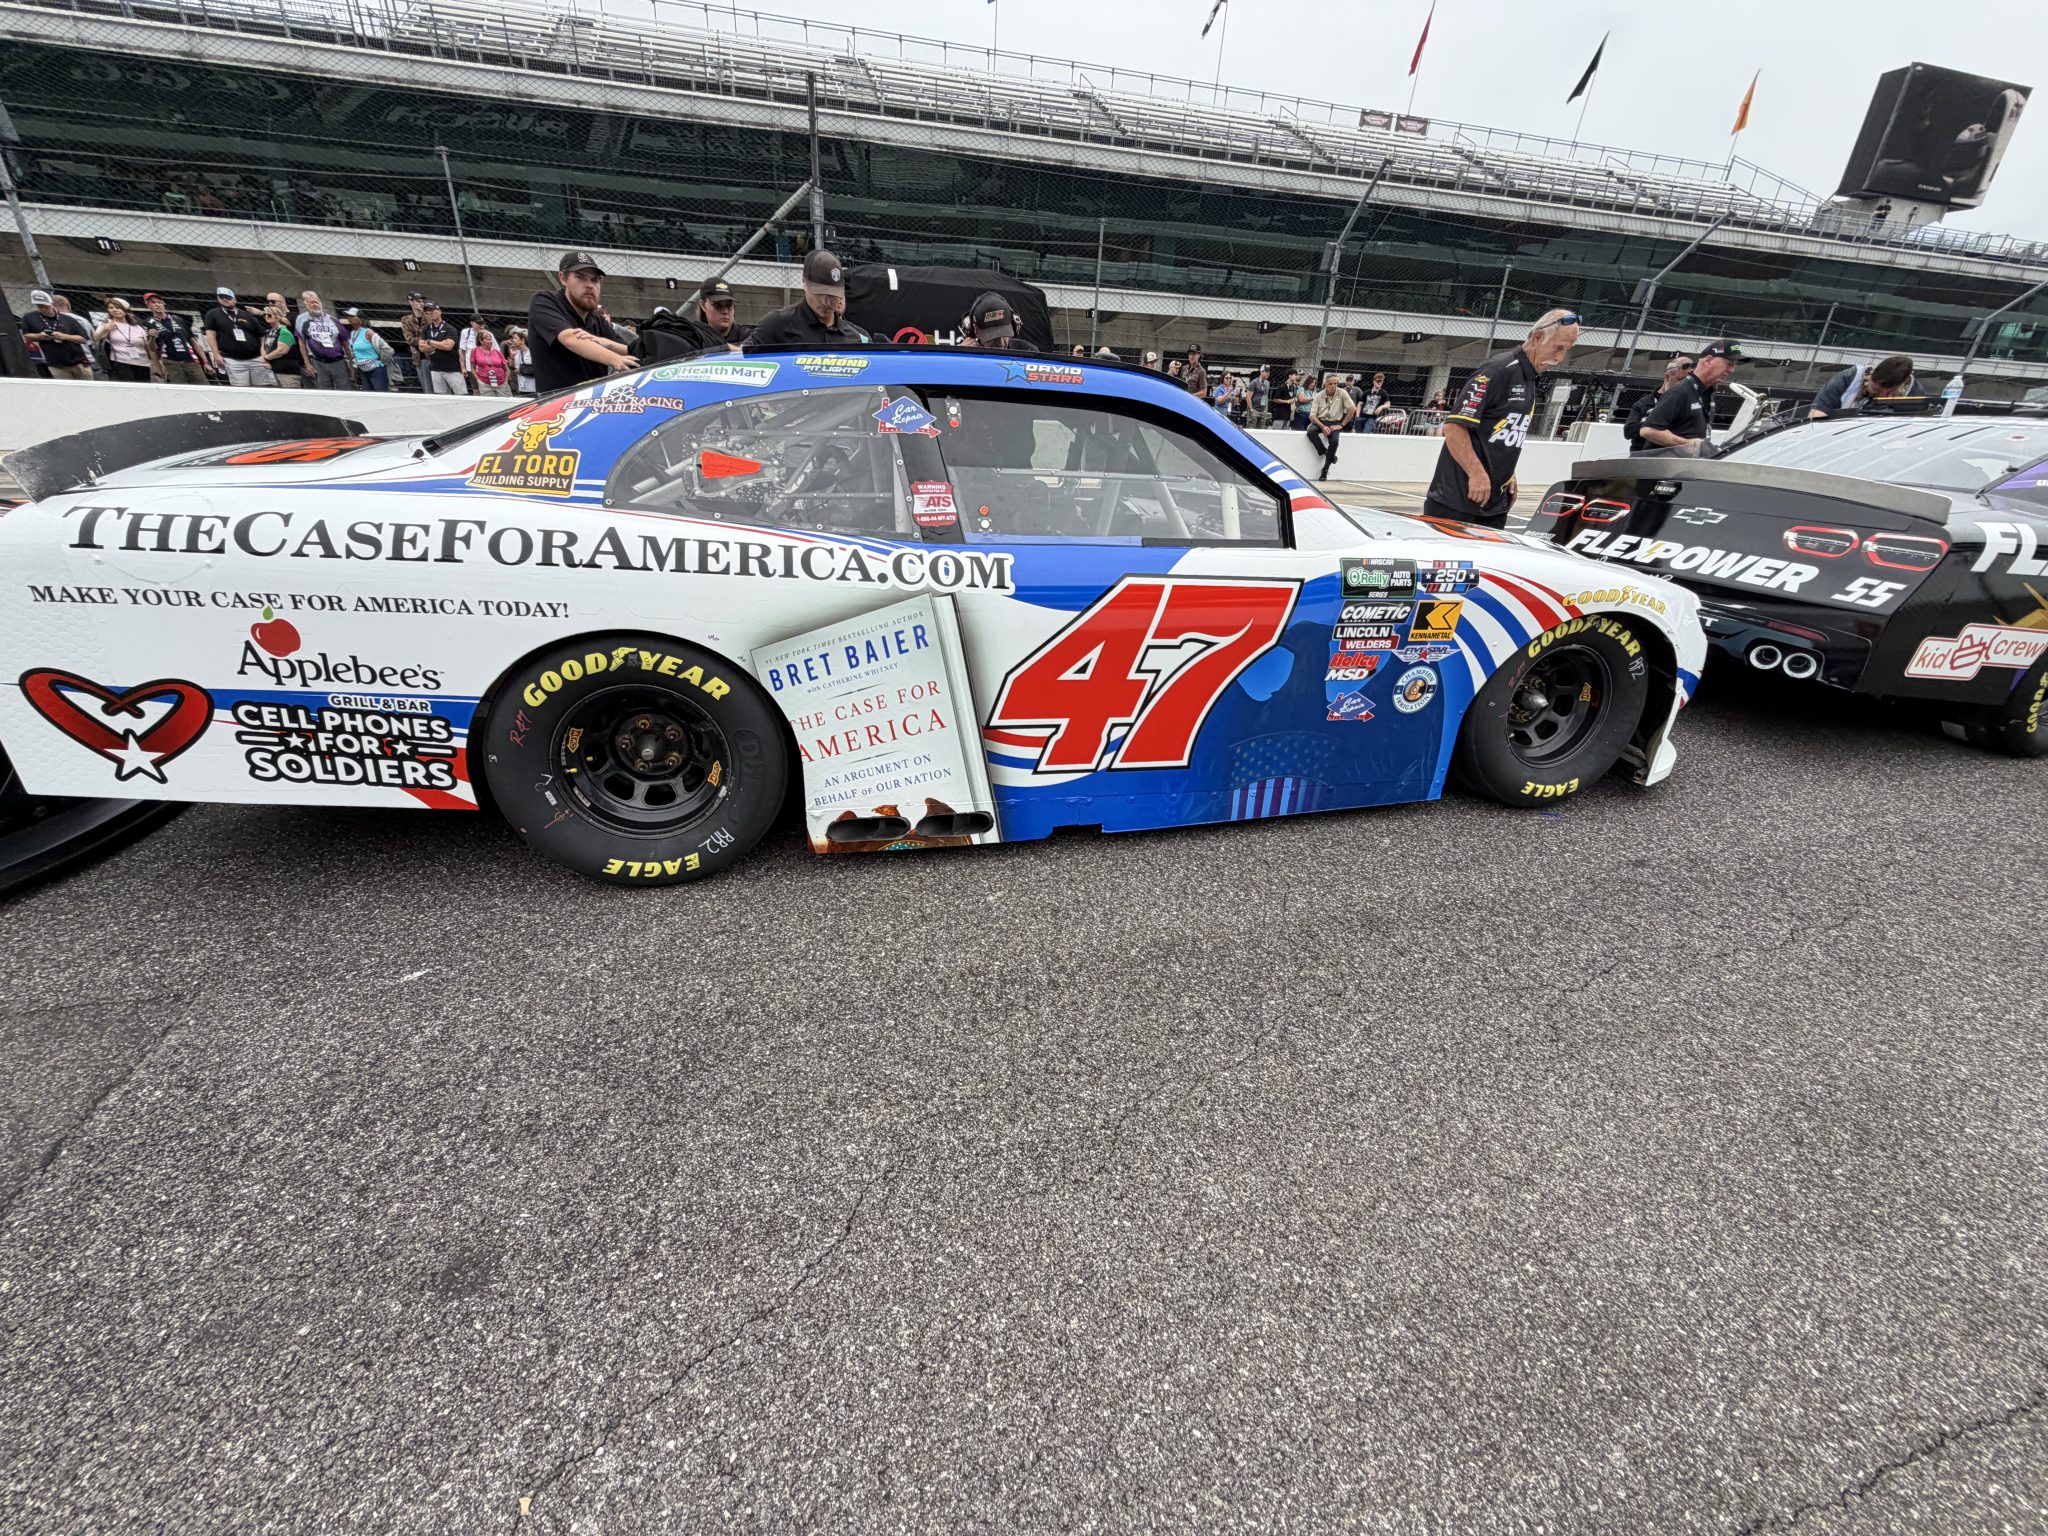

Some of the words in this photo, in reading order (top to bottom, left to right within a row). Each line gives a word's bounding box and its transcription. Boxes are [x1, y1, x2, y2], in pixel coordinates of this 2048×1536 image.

[668, 279, 676, 290] 9
[795, 356, 869, 367] DIAMOND
[802, 365, 822, 373] PIT
[824, 365, 860, 374] LIGHTS
[1025, 364, 1082, 375] DAVID
[682, 366, 728, 375] Health
[731, 367, 767, 379] Mart
[1027, 372, 1084, 385] STARR
[562, 398, 607, 410] FLURRY
[631, 396, 684, 411] RACING
[592, 404, 645, 414] STABLES
[894, 404, 917, 416] Car
[892, 412, 924, 425] Repair
[477, 455, 502, 474] EL
[513, 454, 576, 476] TORO
[473, 475, 524, 486] BUILDING
[526, 475, 570, 489] SUPPLY
[926, 495, 952, 508] ATS
[1370, 558, 1395, 566] NASCAR
[1565, 528, 1820, 594] FLEXPOWER
[1347, 568, 1390, 587] O'Reilly
[1390, 578, 1413, 587] PARTS
[1392, 570, 1411, 579] AUTO
[1434, 569, 1467, 583] 250
[1830, 576, 1909, 608] 55
[27, 585, 118, 605] MAKE
[121, 588, 206, 607] YOUR
[210, 591, 284, 609] CASE
[288, 593, 347, 612] FOR
[353, 596, 475, 615] AMERICA
[478, 599, 570, 618] TODAY!
[1341, 605, 1412, 620] COMETIC
[792, 645, 811, 658] YORK
[813, 638, 836, 653] TIMES
[838, 621, 890, 643] BESTSELLING
[892, 610, 925, 626] AUTHOR
[1336, 626, 1391, 638] LINCOLN
[1410, 632, 1451, 640] KENNAMETAL
[1345, 639, 1392, 650] WELDERS
[1993, 639, 2047, 658] crew
[237, 640, 441, 690] Applebee's
[768, 652, 832, 692] BRET
[844, 624, 930, 670] BAIER
[1330, 652, 1380, 671] Holley
[1914, 646, 1951, 669] kid
[806, 685, 821, 694] with
[822, 672, 863, 690] CATHERINE
[864, 662, 899, 677] WHITNEY
[987, 573, 1304, 774] 47
[1325, 669, 1370, 681] MSD
[1401, 668, 1436, 684] CHAMPION
[331, 694, 379, 709] GRILL
[382, 698, 393, 710] &
[396, 700, 430, 712] BAR
[834, 694, 888, 721] CASE
[897, 680, 942, 704] FOR
[1395, 694, 1430, 711] IRRIGATION
[236, 704, 317, 730] CELL
[323, 711, 449, 740] PHONES
[317, 732, 383, 756] FOR
[250, 751, 454, 787] SOLDIERS
[824, 775, 840, 788] AN
[843, 759, 910, 783] ARGUMENT
[913, 753, 932, 767] ON
[813, 789, 858, 807] BEHALF
[861, 787, 873, 796] OF
[876, 777, 902, 792] OUR
[904, 767, 952, 786] NATION
[1521, 777, 1580, 798] EAGLE
[601, 851, 701, 878] EAGLE
